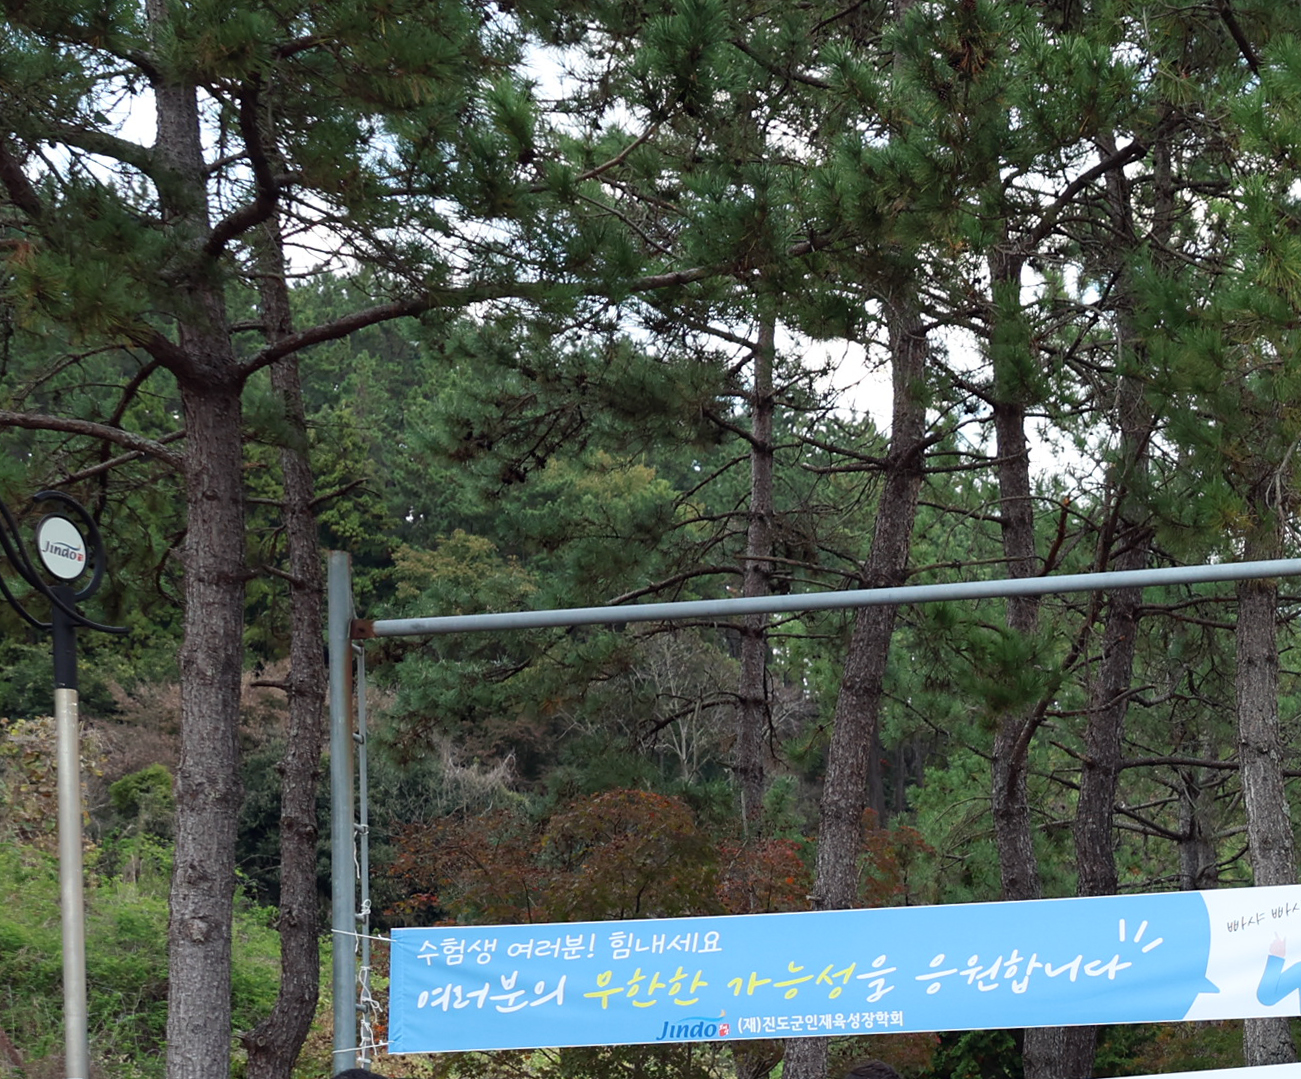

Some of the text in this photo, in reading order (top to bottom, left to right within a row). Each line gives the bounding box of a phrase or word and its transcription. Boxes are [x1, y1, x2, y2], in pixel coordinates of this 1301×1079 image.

[42, 541, 77, 560] Jindo
[416, 929, 724, 966] 수험생 여러분! 힘내세요
[416, 949, 1132, 1013] 여러분의 무한한 가능성을 응원합니다
[656, 1017, 718, 1041] Jindo
[737, 1009, 904, 1036] (재)진도군인재육성장학회
